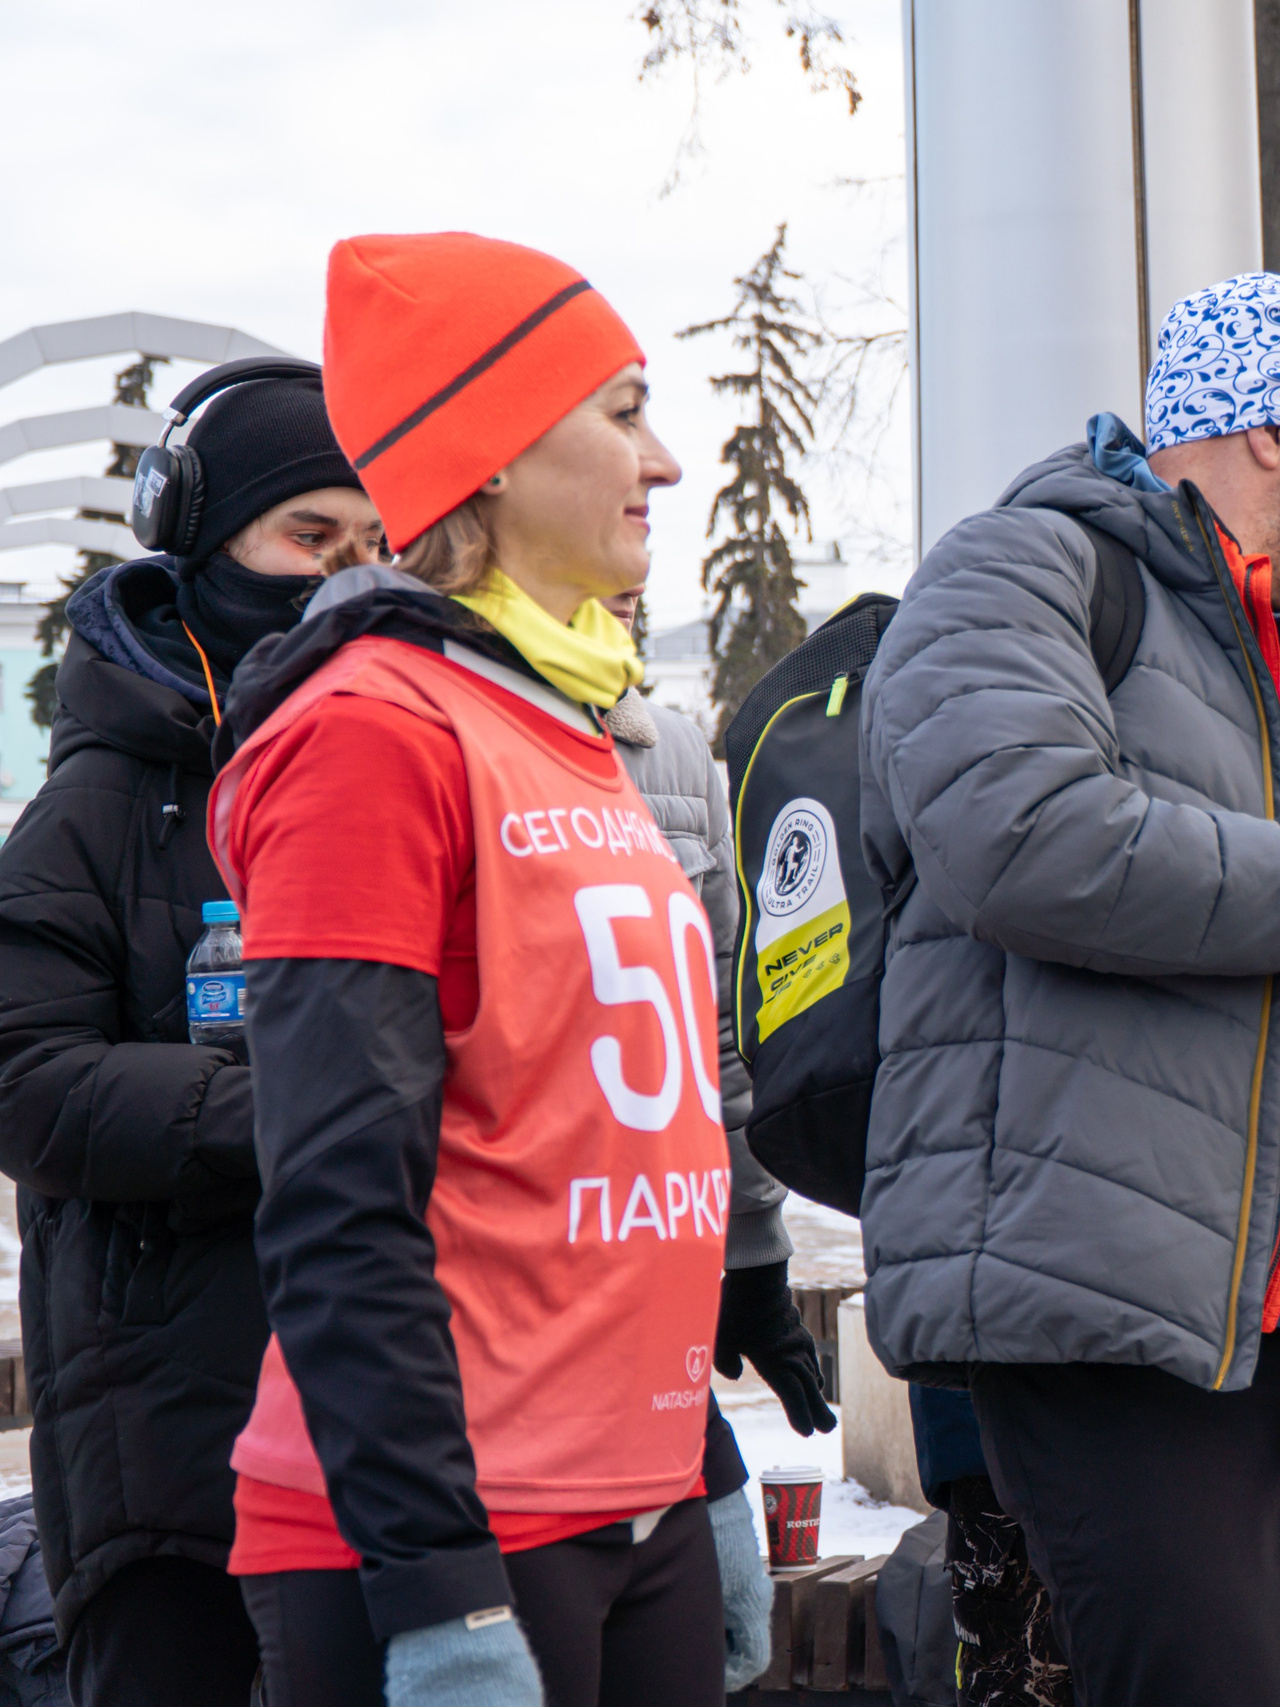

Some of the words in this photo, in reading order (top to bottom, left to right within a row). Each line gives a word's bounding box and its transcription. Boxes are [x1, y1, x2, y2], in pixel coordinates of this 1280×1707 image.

[795, 818, 814, 832] RING
[767, 897, 793, 909] ULTRA
[795, 865, 819, 899] TRAIL
[765, 922, 844, 976] NEVER
[573, 883, 722, 1132] 50
[568, 1168, 731, 1243] ПАРКР
